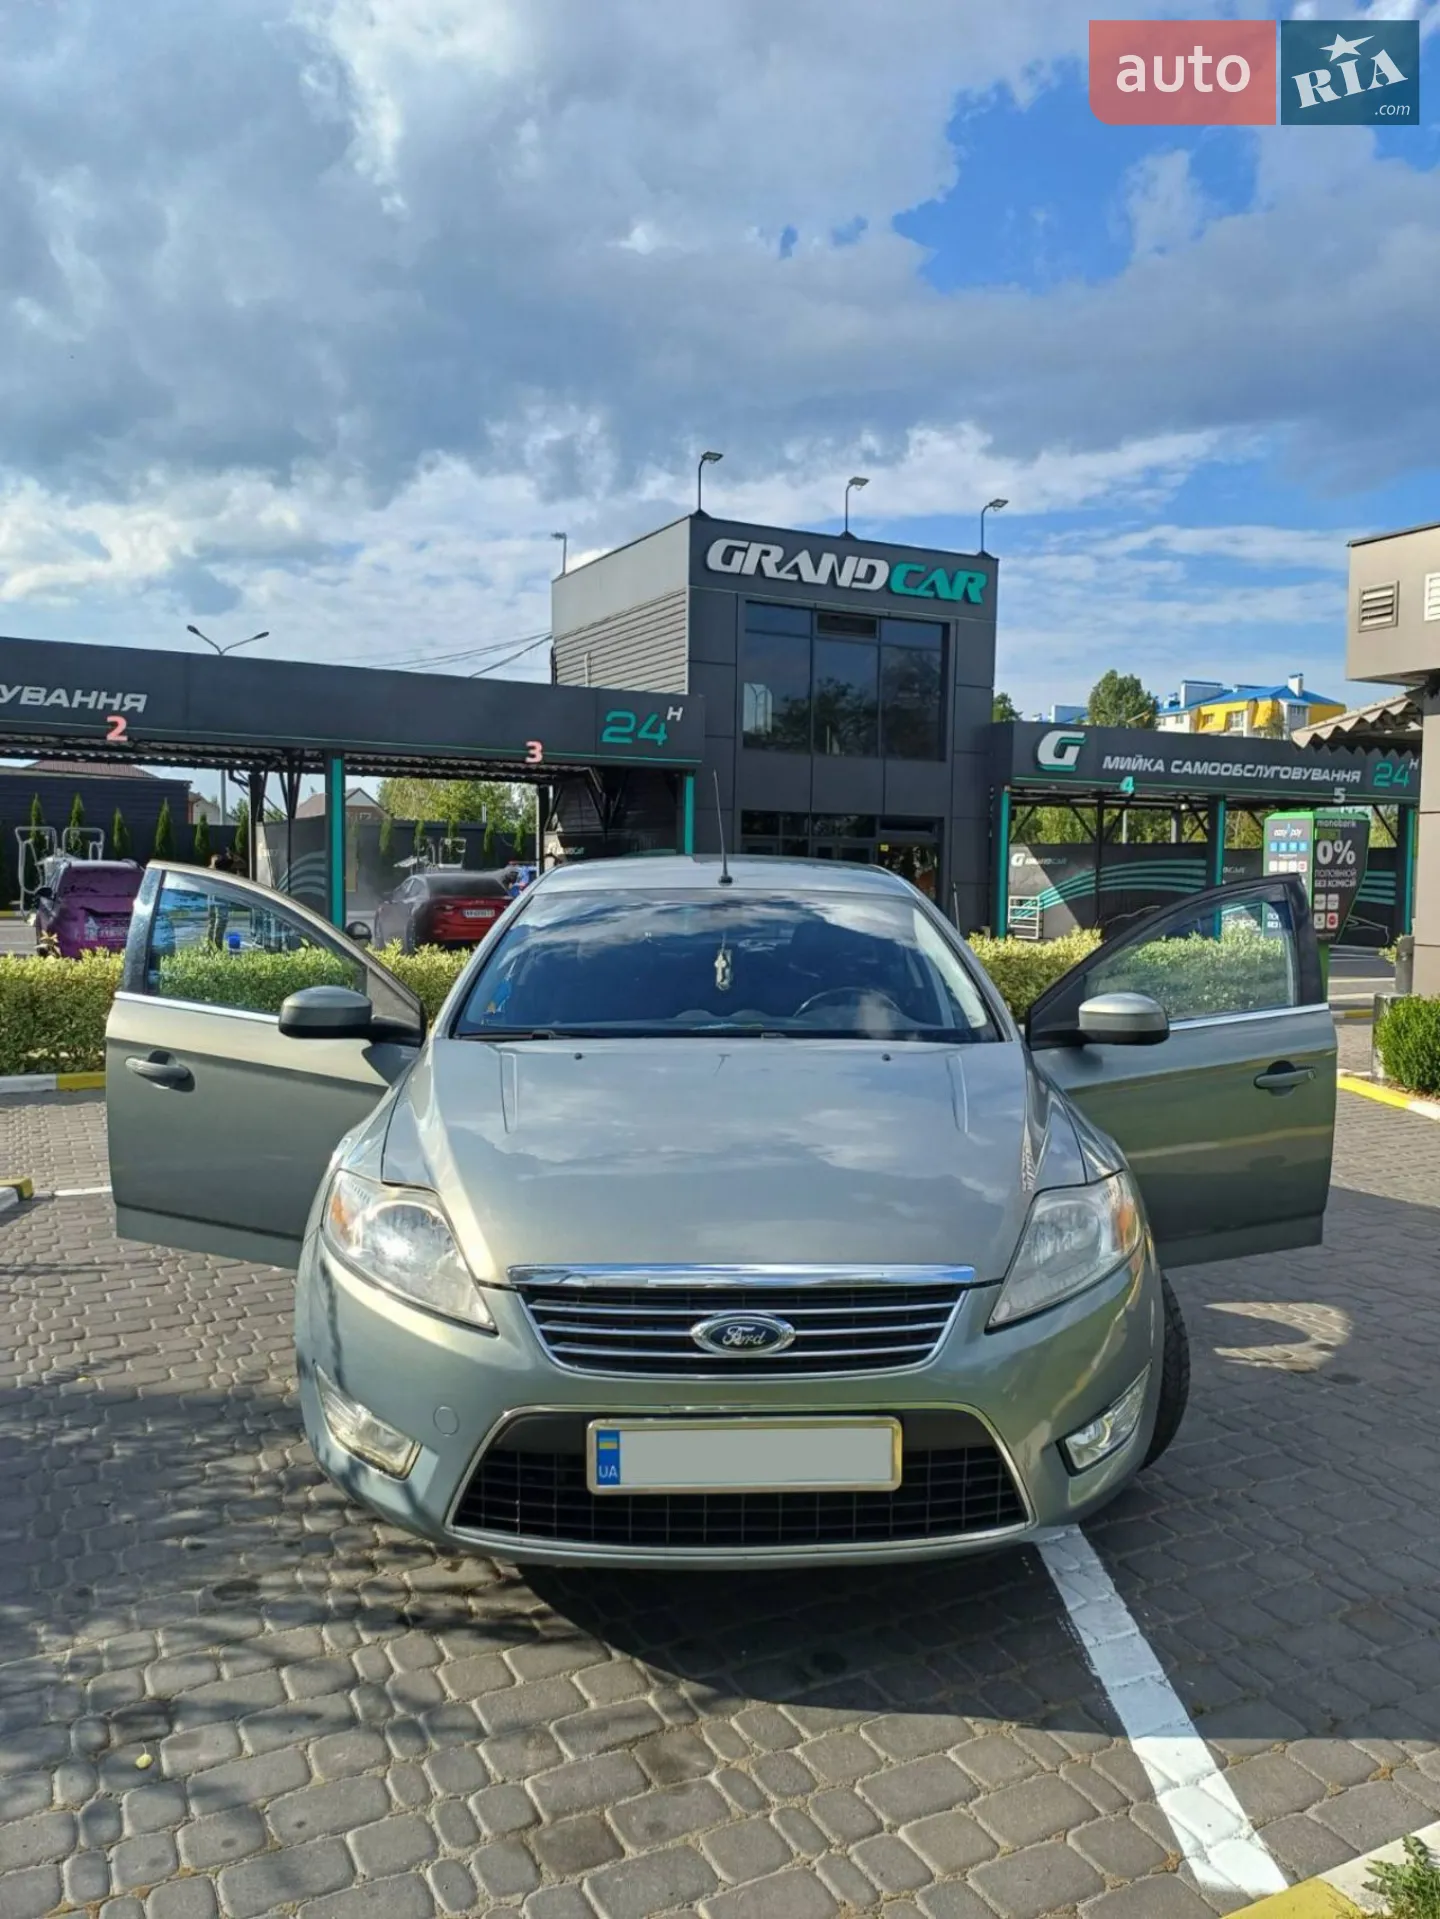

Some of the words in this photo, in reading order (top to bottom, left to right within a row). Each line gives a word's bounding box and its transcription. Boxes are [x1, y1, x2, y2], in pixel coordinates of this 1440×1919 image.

[706, 538, 987, 604] GRANDCAR
[106, 715, 128, 741] 2
[525, 741, 543, 763] 3
[1102, 754, 1165, 773] МИЙКА
[1170, 760, 1362, 783] САМООБСЛУГОВУВАННЯ
[1119, 776, 1135, 794] 4
[1333, 787, 1346, 803] 5
[1317, 840, 1356, 865] 0%
[721, 1325, 765, 1346] Ford
[599, 1464, 618, 1478] UA
